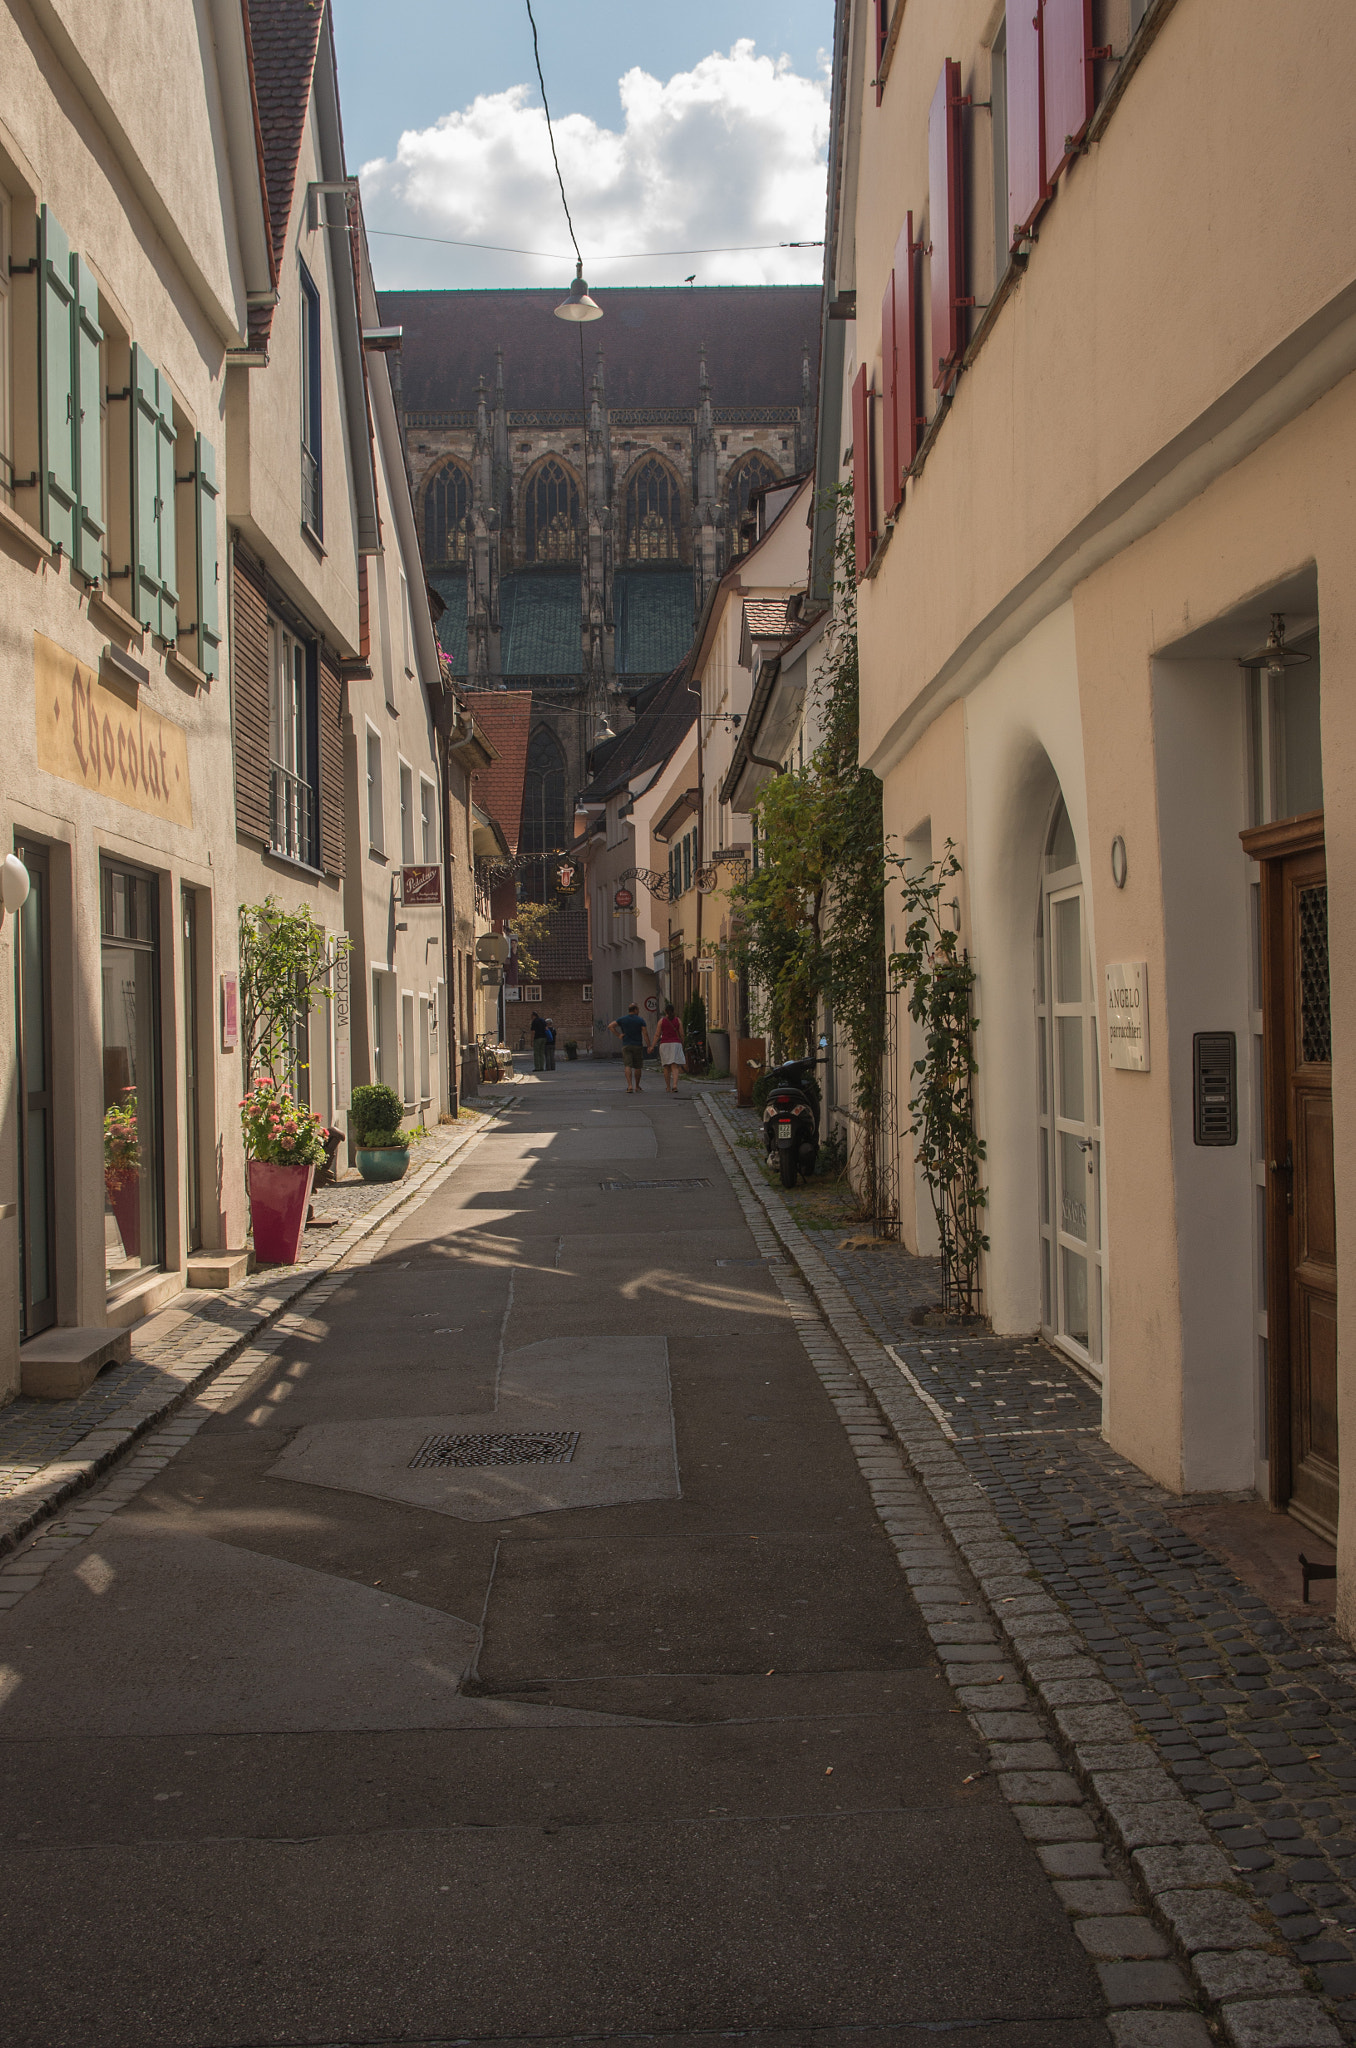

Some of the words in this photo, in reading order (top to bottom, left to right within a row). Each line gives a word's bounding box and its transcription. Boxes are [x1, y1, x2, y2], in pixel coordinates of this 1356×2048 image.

[72, 664, 170, 804] Chocolat
[334, 935, 349, 1027] werkraum
[1109, 988, 1140, 1008] ANGELO
